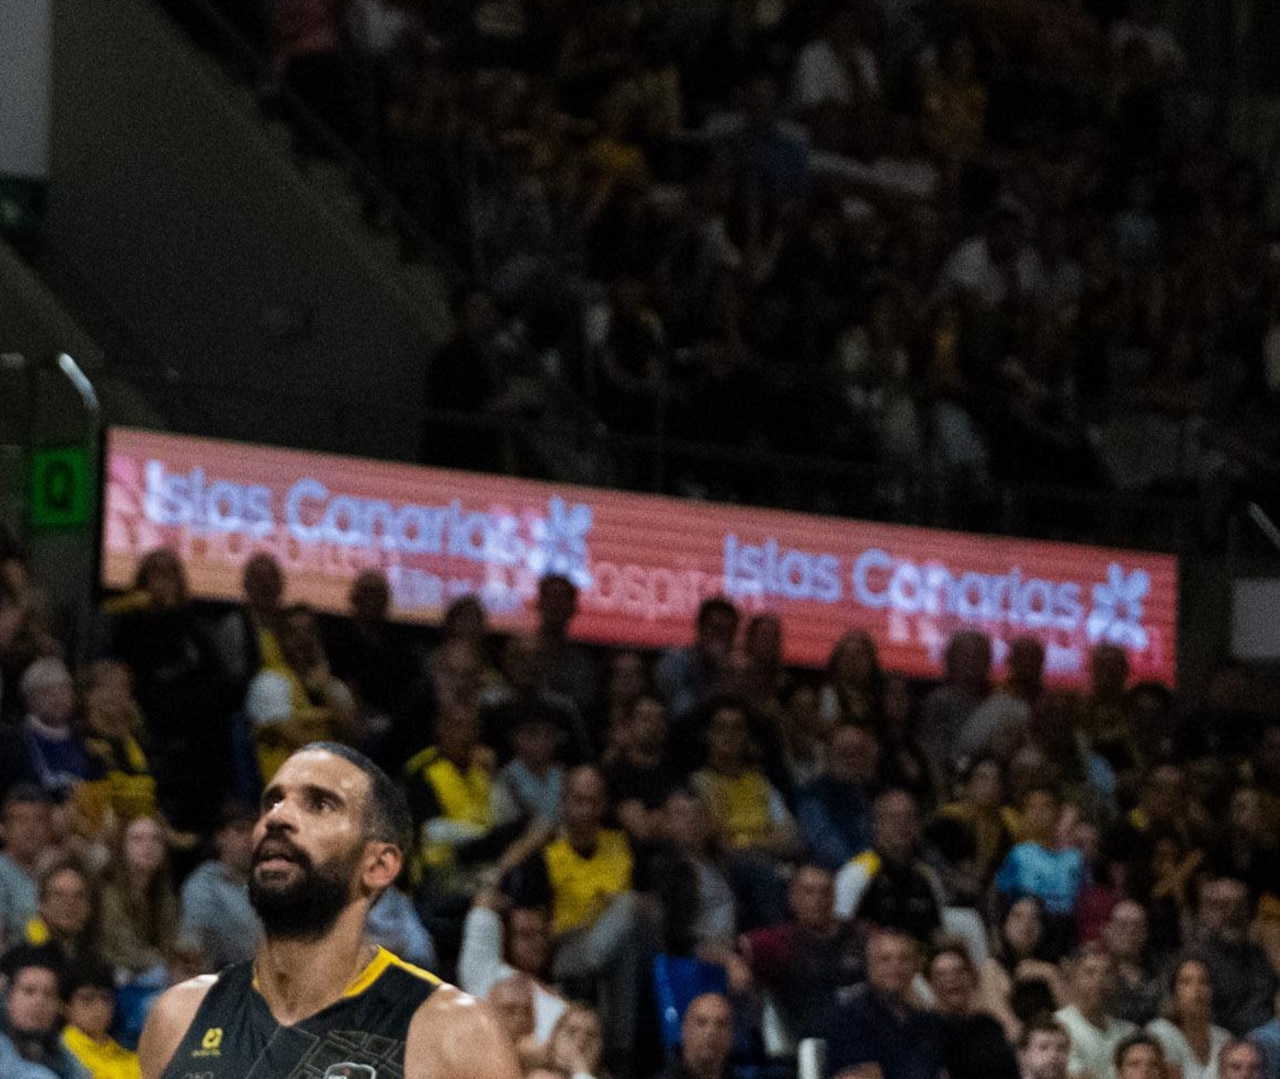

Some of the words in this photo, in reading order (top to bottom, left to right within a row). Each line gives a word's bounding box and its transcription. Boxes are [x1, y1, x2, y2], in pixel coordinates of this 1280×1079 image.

[145, 459, 272, 536] Islas
[724, 533, 840, 602] Islas
[852, 548, 1083, 630] Canarias
